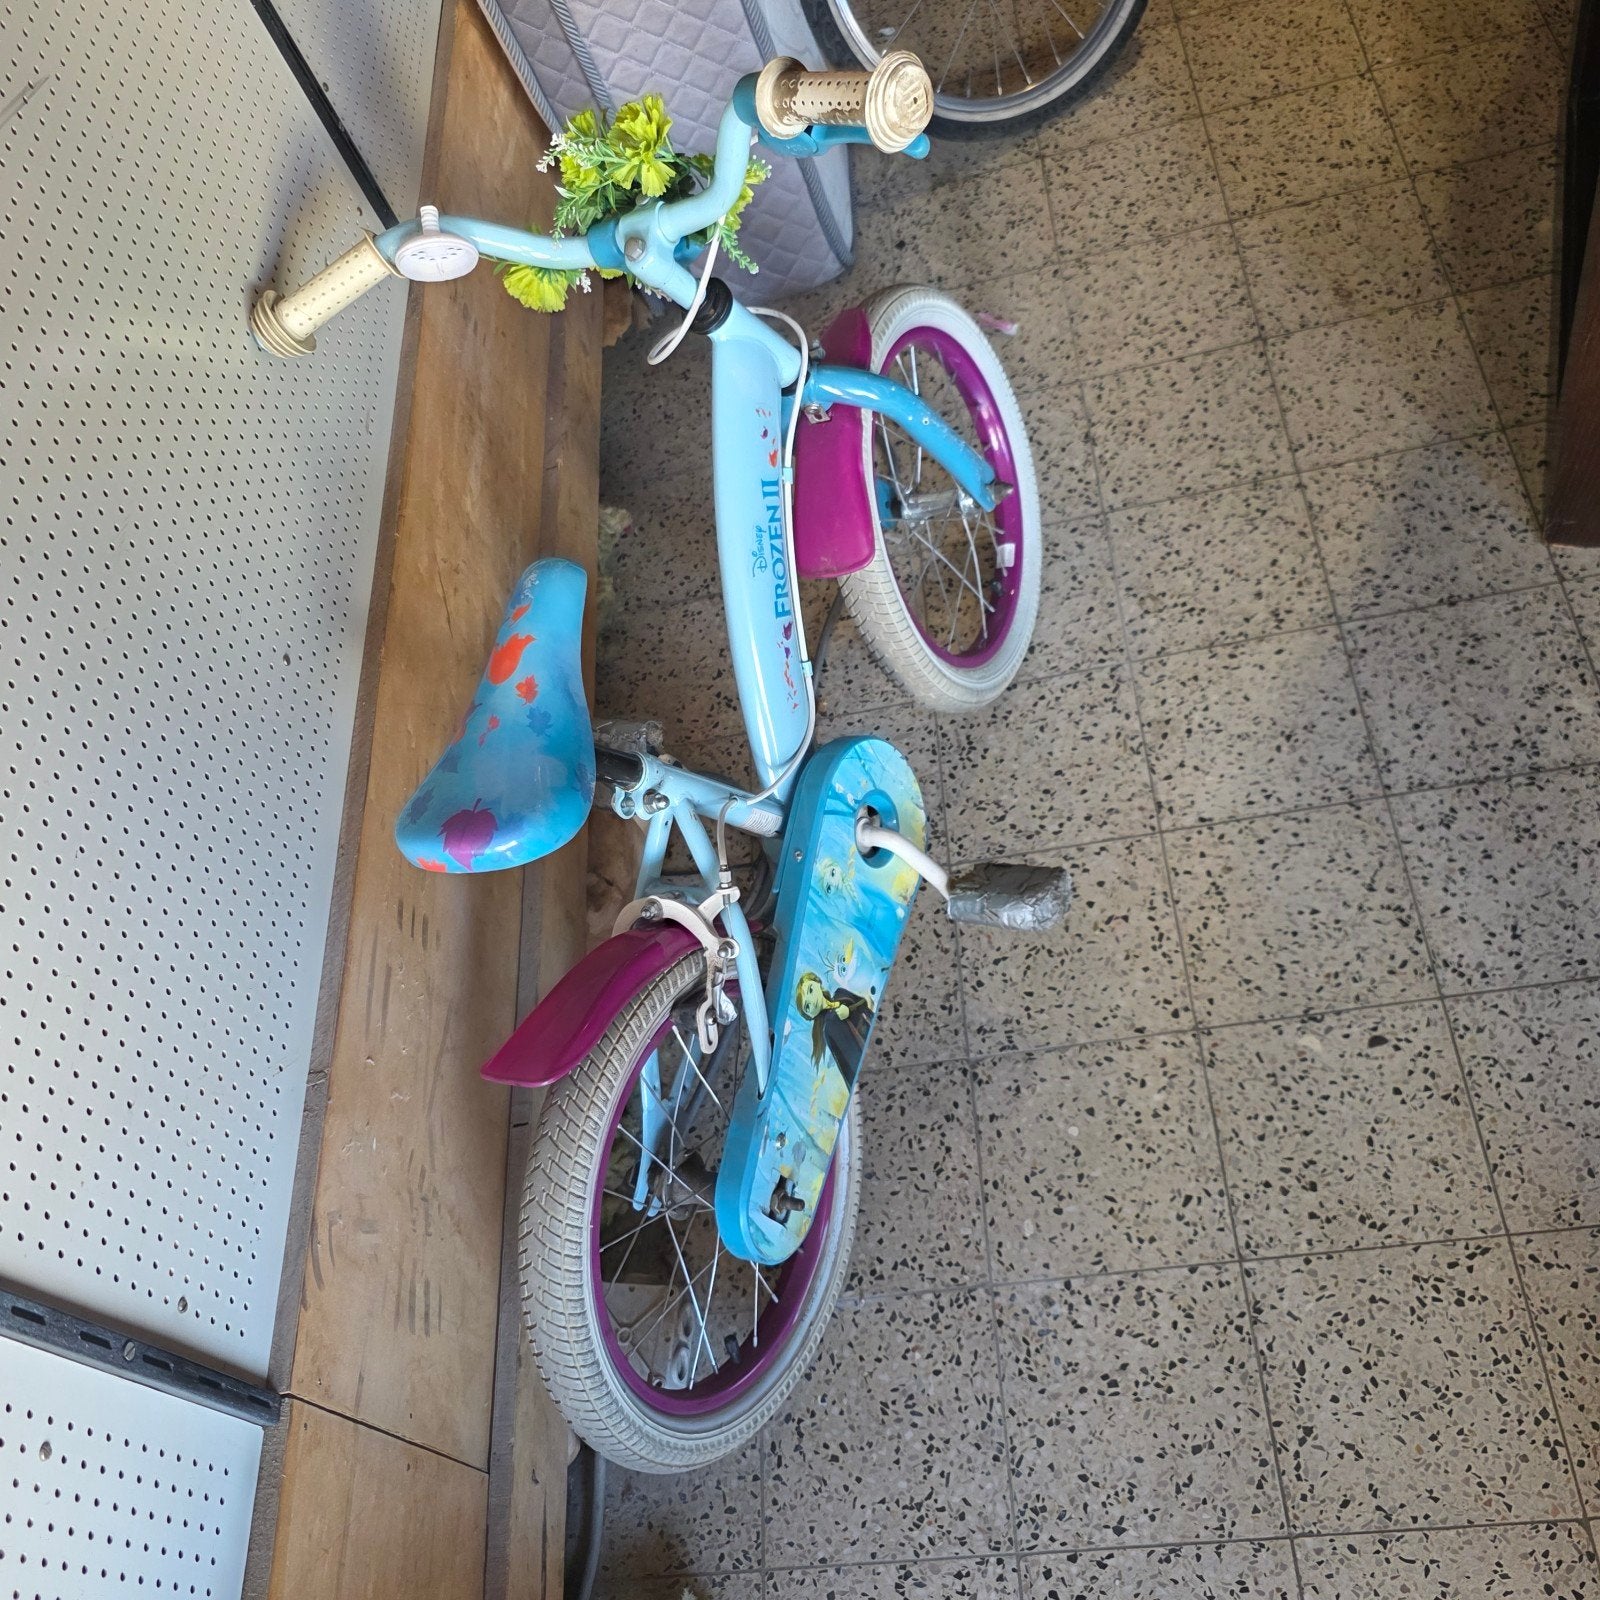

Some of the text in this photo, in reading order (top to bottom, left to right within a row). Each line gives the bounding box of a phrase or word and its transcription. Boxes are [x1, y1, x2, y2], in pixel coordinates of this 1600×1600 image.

[752, 525, 768, 577] Disney
[761, 478, 792, 619] FROZEN II
